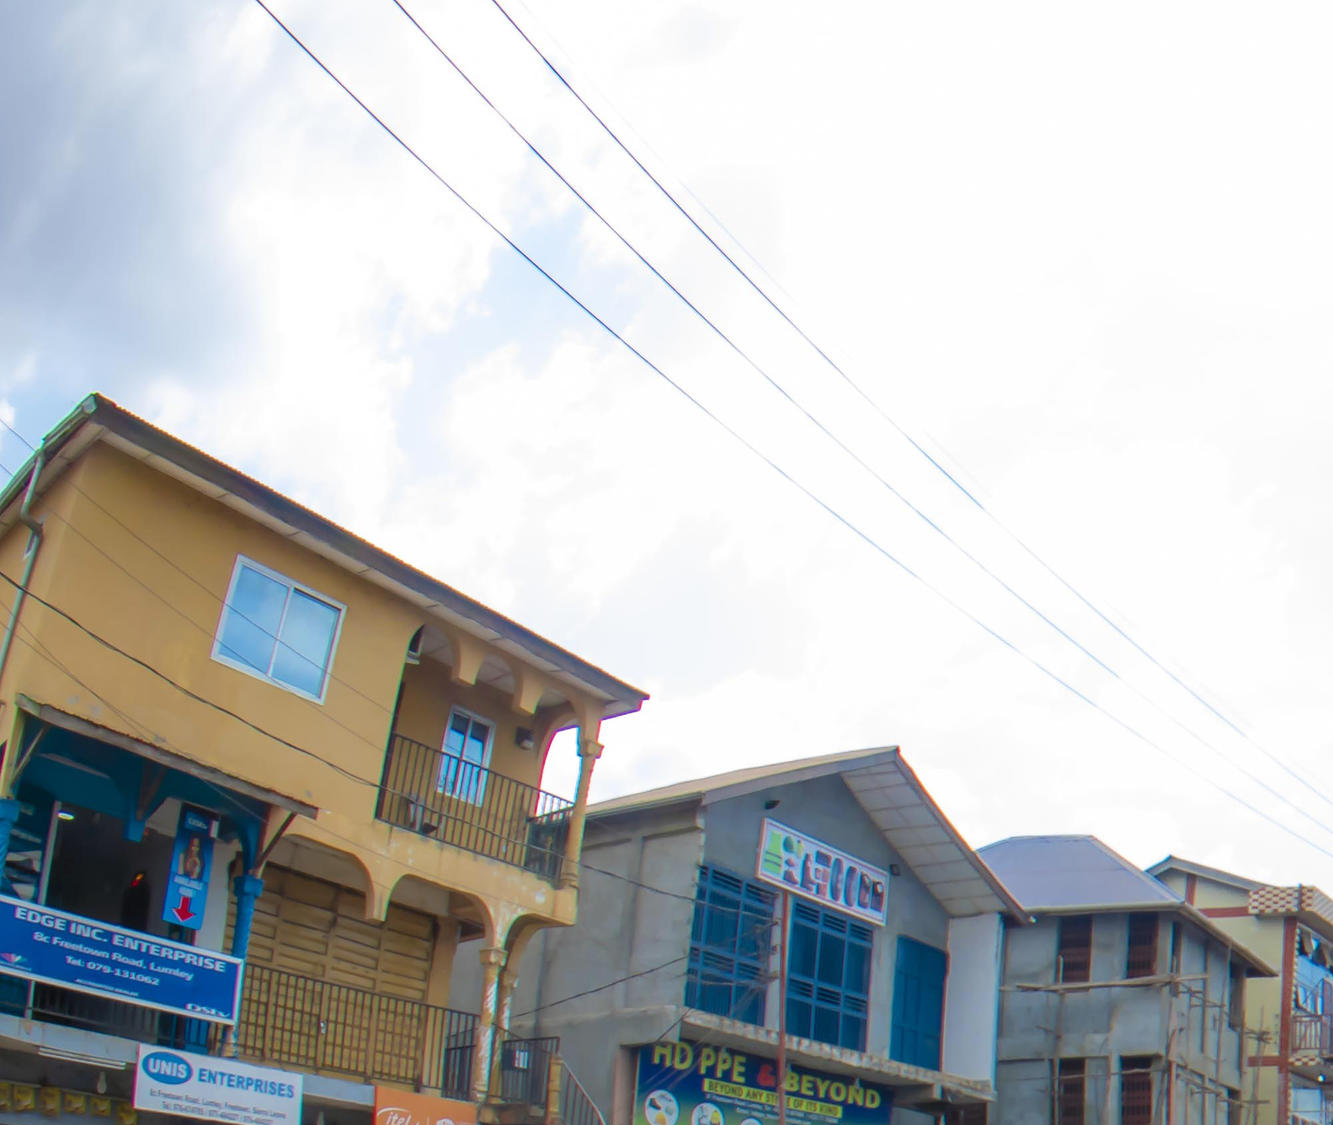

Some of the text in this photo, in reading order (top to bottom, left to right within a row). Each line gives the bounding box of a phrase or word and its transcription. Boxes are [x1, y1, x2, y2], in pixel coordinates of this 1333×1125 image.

[15, 905, 227, 974] EDGE INC. ENTERPRISE
[51, 936, 110, 960] Freetown
[149, 960, 194, 982] Lumley
[148, 1058, 295, 1099] UNIS ENTERPRISES
[700, 1048, 747, 1084] PPE
[785, 1071, 881, 1109] BEYOND
